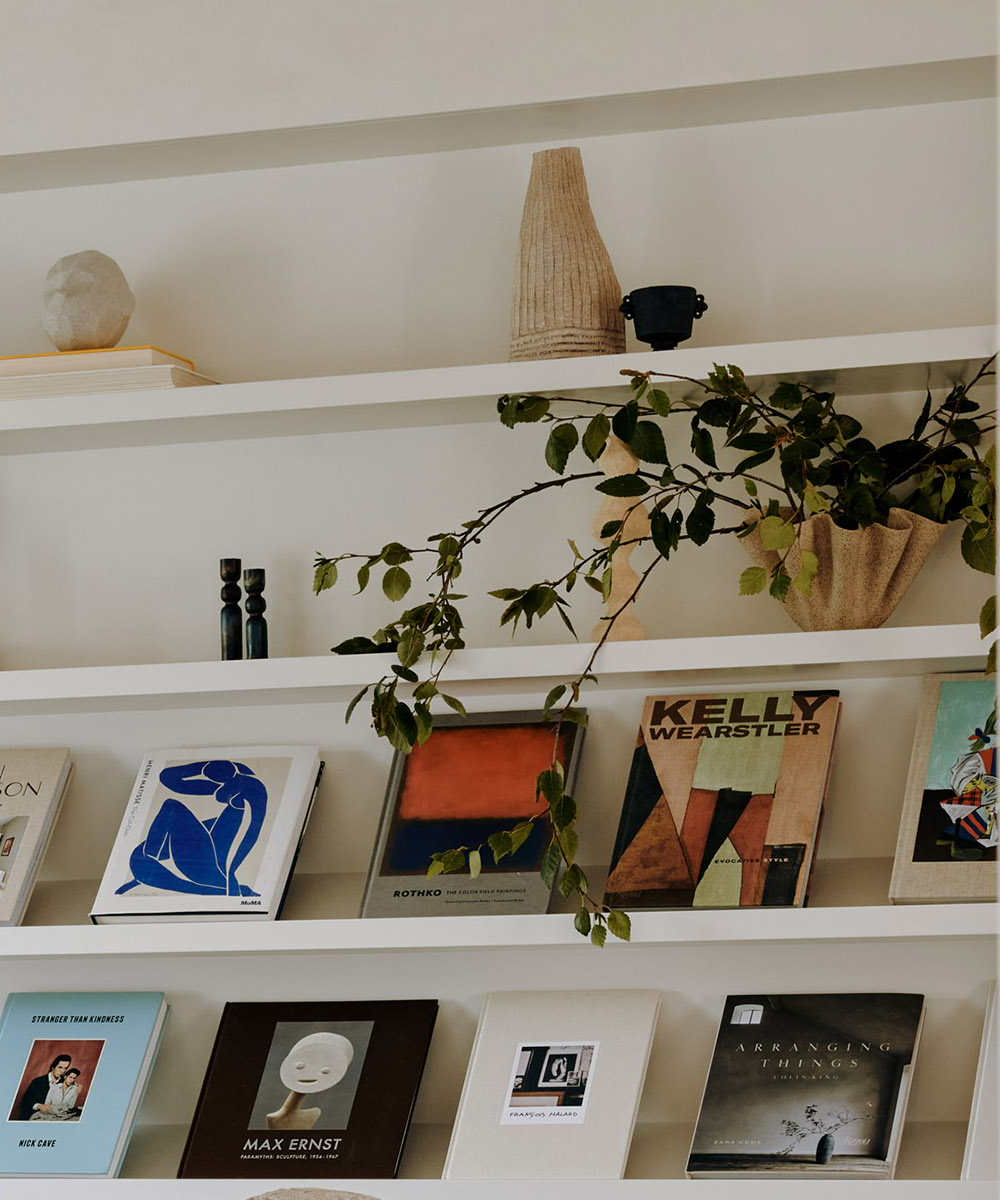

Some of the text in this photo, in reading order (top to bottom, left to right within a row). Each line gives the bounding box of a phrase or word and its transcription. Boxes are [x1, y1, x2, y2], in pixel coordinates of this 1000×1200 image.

[650, 695, 832, 726] KELLY
[650, 722, 821, 740] WEARSTLER
[142, 760, 153, 778] HENRI
[134, 780, 146, 804] MATISSE
[393, 889, 442, 898] ROTHKO
[31, 1015, 125, 1023] STRANGER THAN KINDNESS
[735, 1042, 891, 1052] ARRANGING
[760, 1058, 858, 1068] THINGS
[18, 1140, 57, 1148] NICK CAVE
[242, 1138, 342, 1151] MAX ERNST
